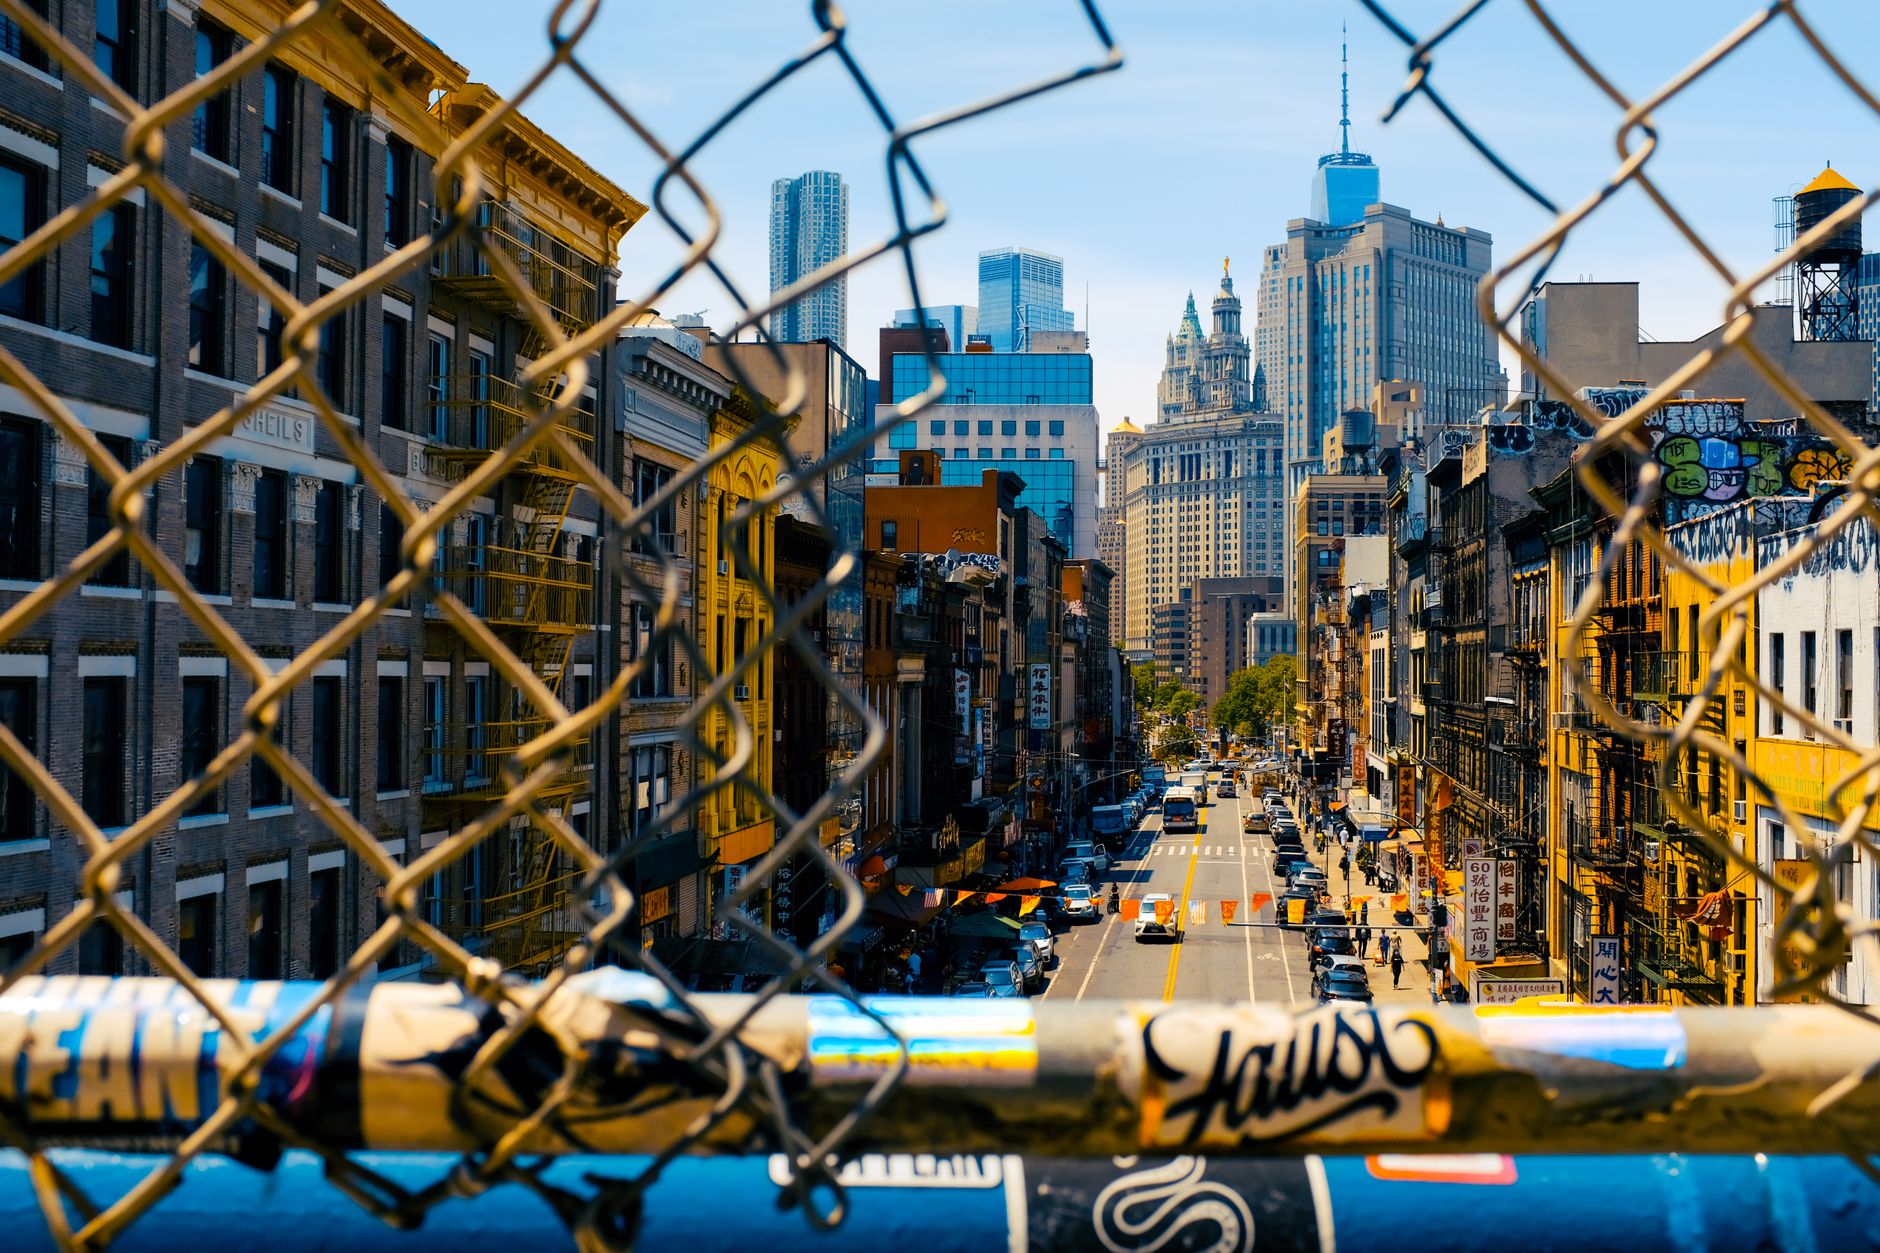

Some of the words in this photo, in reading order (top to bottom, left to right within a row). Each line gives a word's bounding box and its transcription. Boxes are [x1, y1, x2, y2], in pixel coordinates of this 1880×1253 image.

[776, 858, 793, 937] 榕服務中心
[1470, 862, 1490, 959] 60號怡豐商場
[1594, 941, 1618, 1005] 開心大
